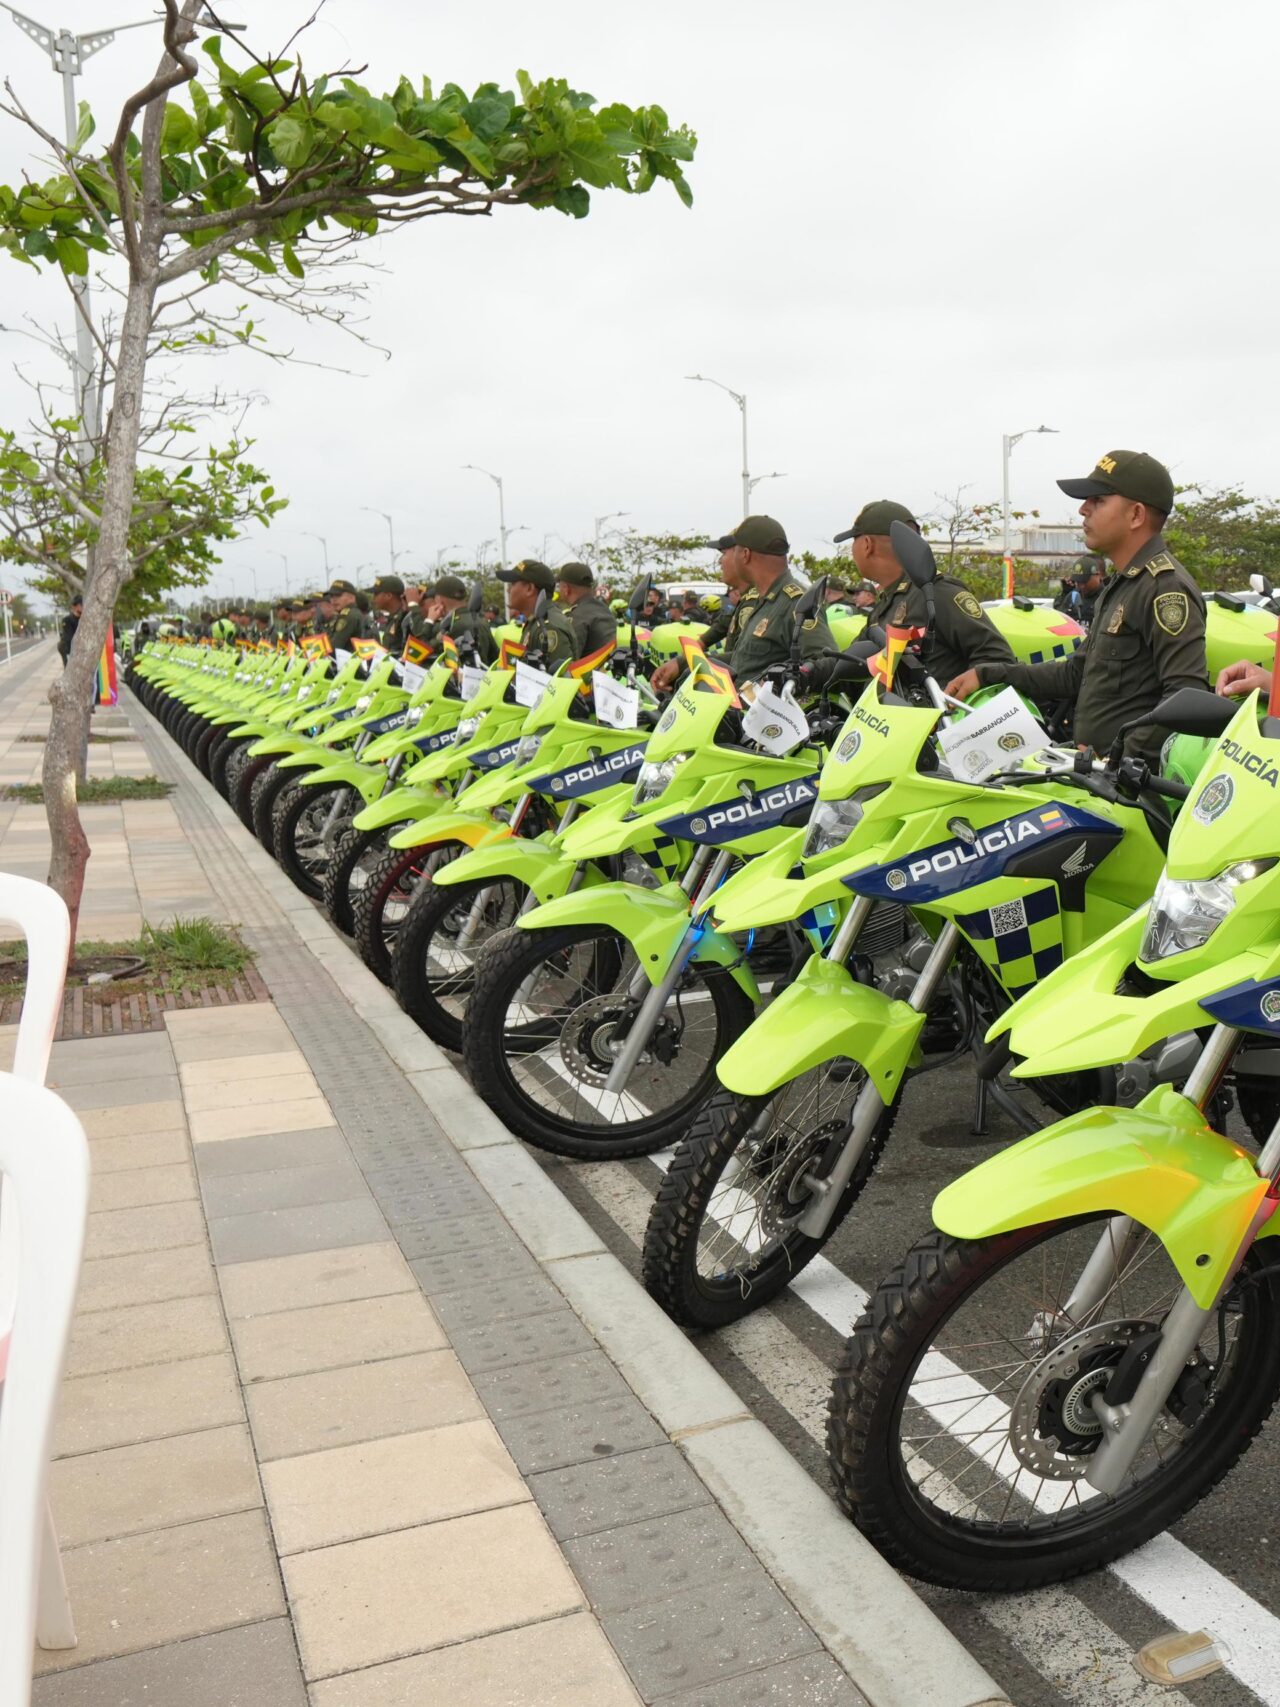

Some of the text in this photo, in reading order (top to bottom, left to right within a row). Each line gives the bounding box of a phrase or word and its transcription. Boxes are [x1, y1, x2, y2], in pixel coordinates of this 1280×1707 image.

[970, 706, 1020, 739] BARRANQUILLA
[564, 749, 645, 787] POLICÍA
[1218, 738, 1279, 789] POLICÍA
[708, 784, 815, 829] POLICÍA
[908, 819, 1042, 882] POLICÍA
[1064, 862, 1095, 879] HONDA
